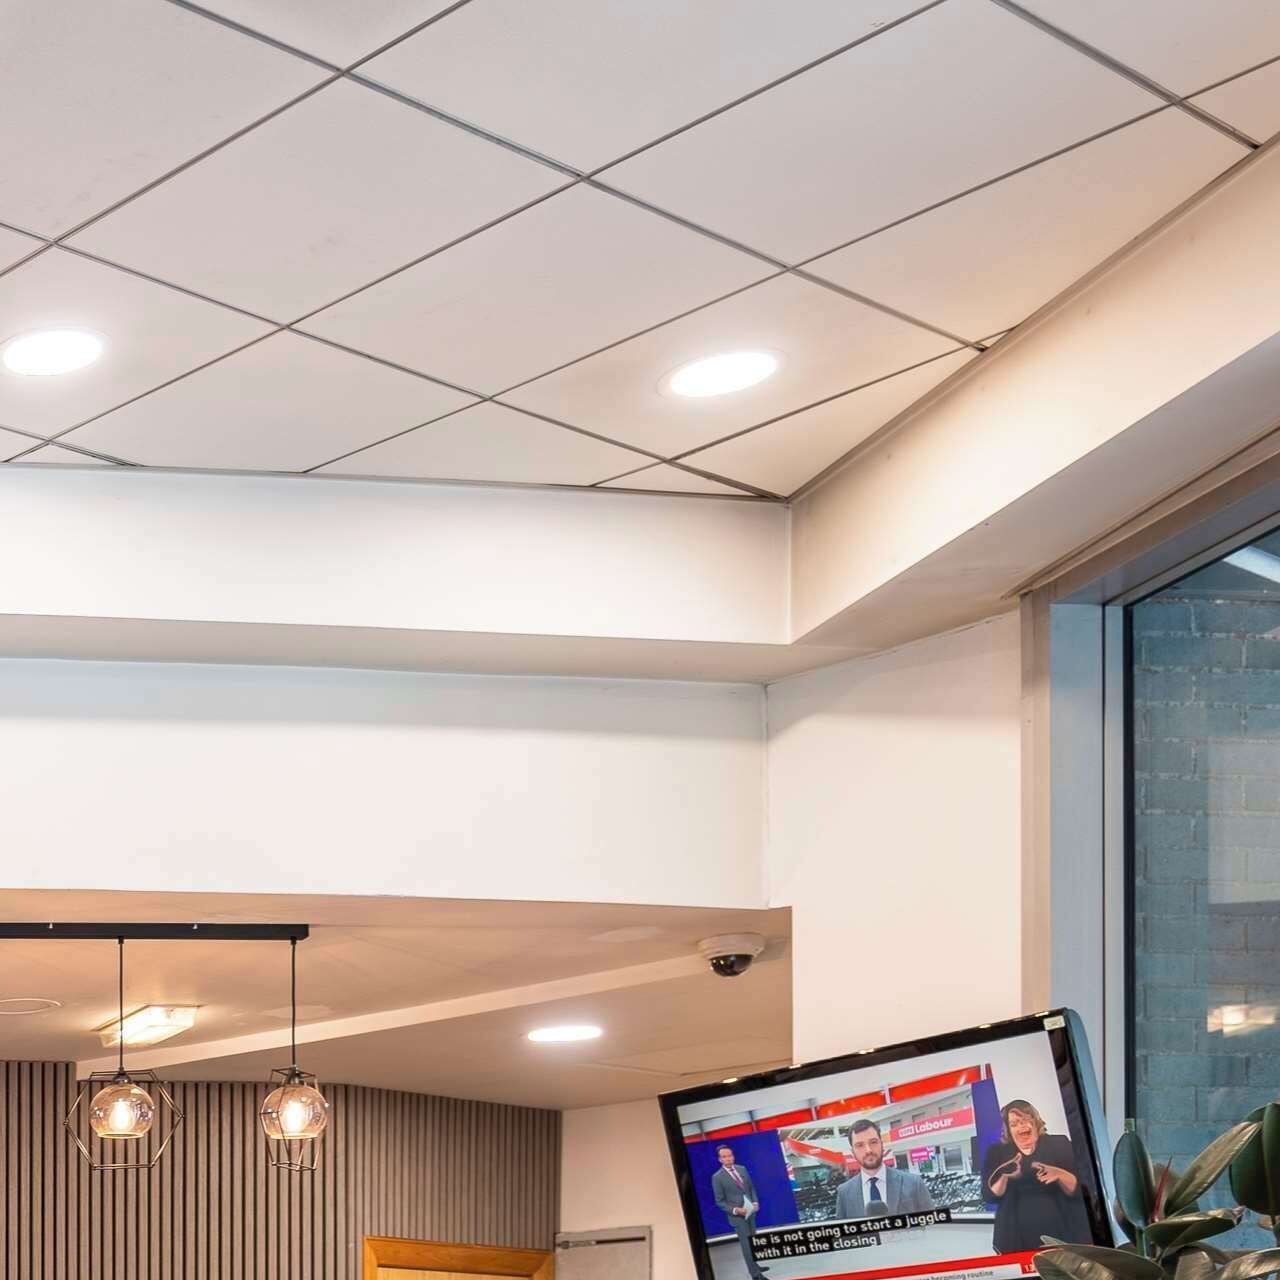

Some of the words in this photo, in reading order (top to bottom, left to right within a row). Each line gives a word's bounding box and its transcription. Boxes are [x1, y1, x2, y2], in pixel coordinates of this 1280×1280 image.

[915, 1118, 953, 1134] Labour
[752, 1237, 767, 1246] he
[771, 1234, 780, 1244] is
[784, 1231, 804, 1241] not
[807, 1227, 840, 1241] going
[844, 1224, 857, 1234] to
[860, 1219, 891, 1231] start
[895, 1218, 902, 1227] a
[905, 1212, 947, 1228] juggle
[755, 1249, 780, 1259] with
[783, 1246, 792, 1255] it
[795, 1244, 806, 1254] in
[810, 1242, 829, 1252] the
[833, 1235, 877, 1249] closing
[967, 1270, 994, 1279] routine
